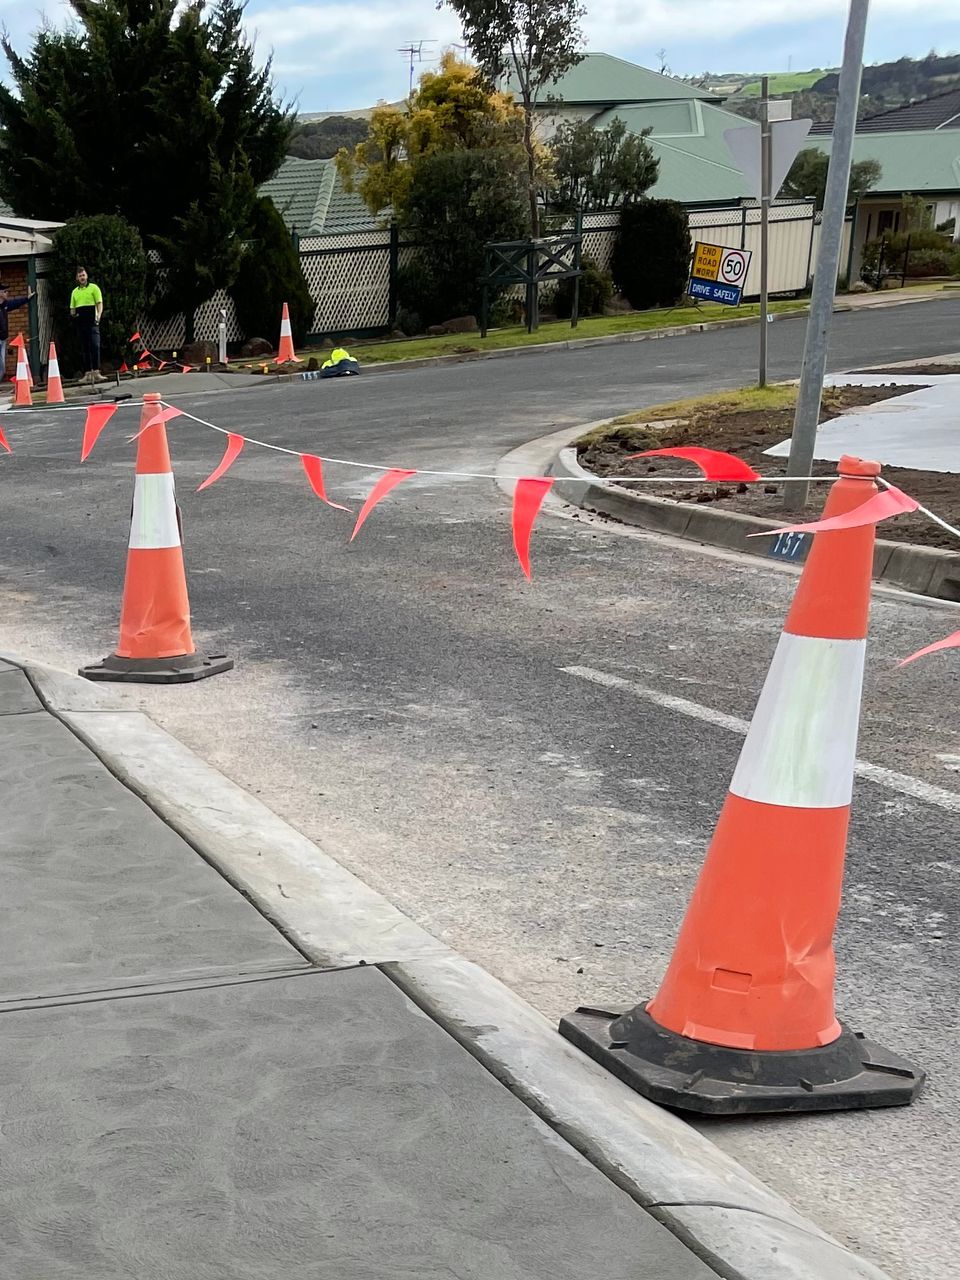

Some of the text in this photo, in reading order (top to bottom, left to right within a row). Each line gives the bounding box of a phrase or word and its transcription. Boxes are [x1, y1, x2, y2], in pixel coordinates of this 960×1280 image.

[702, 247, 717, 256] END
[697, 257, 717, 267] ROAD
[724, 259, 742, 276] 50
[695, 268, 716, 278] WORK
[692, 284, 737, 300] DRIVE SAFELY
[773, 532, 805, 556] 157
